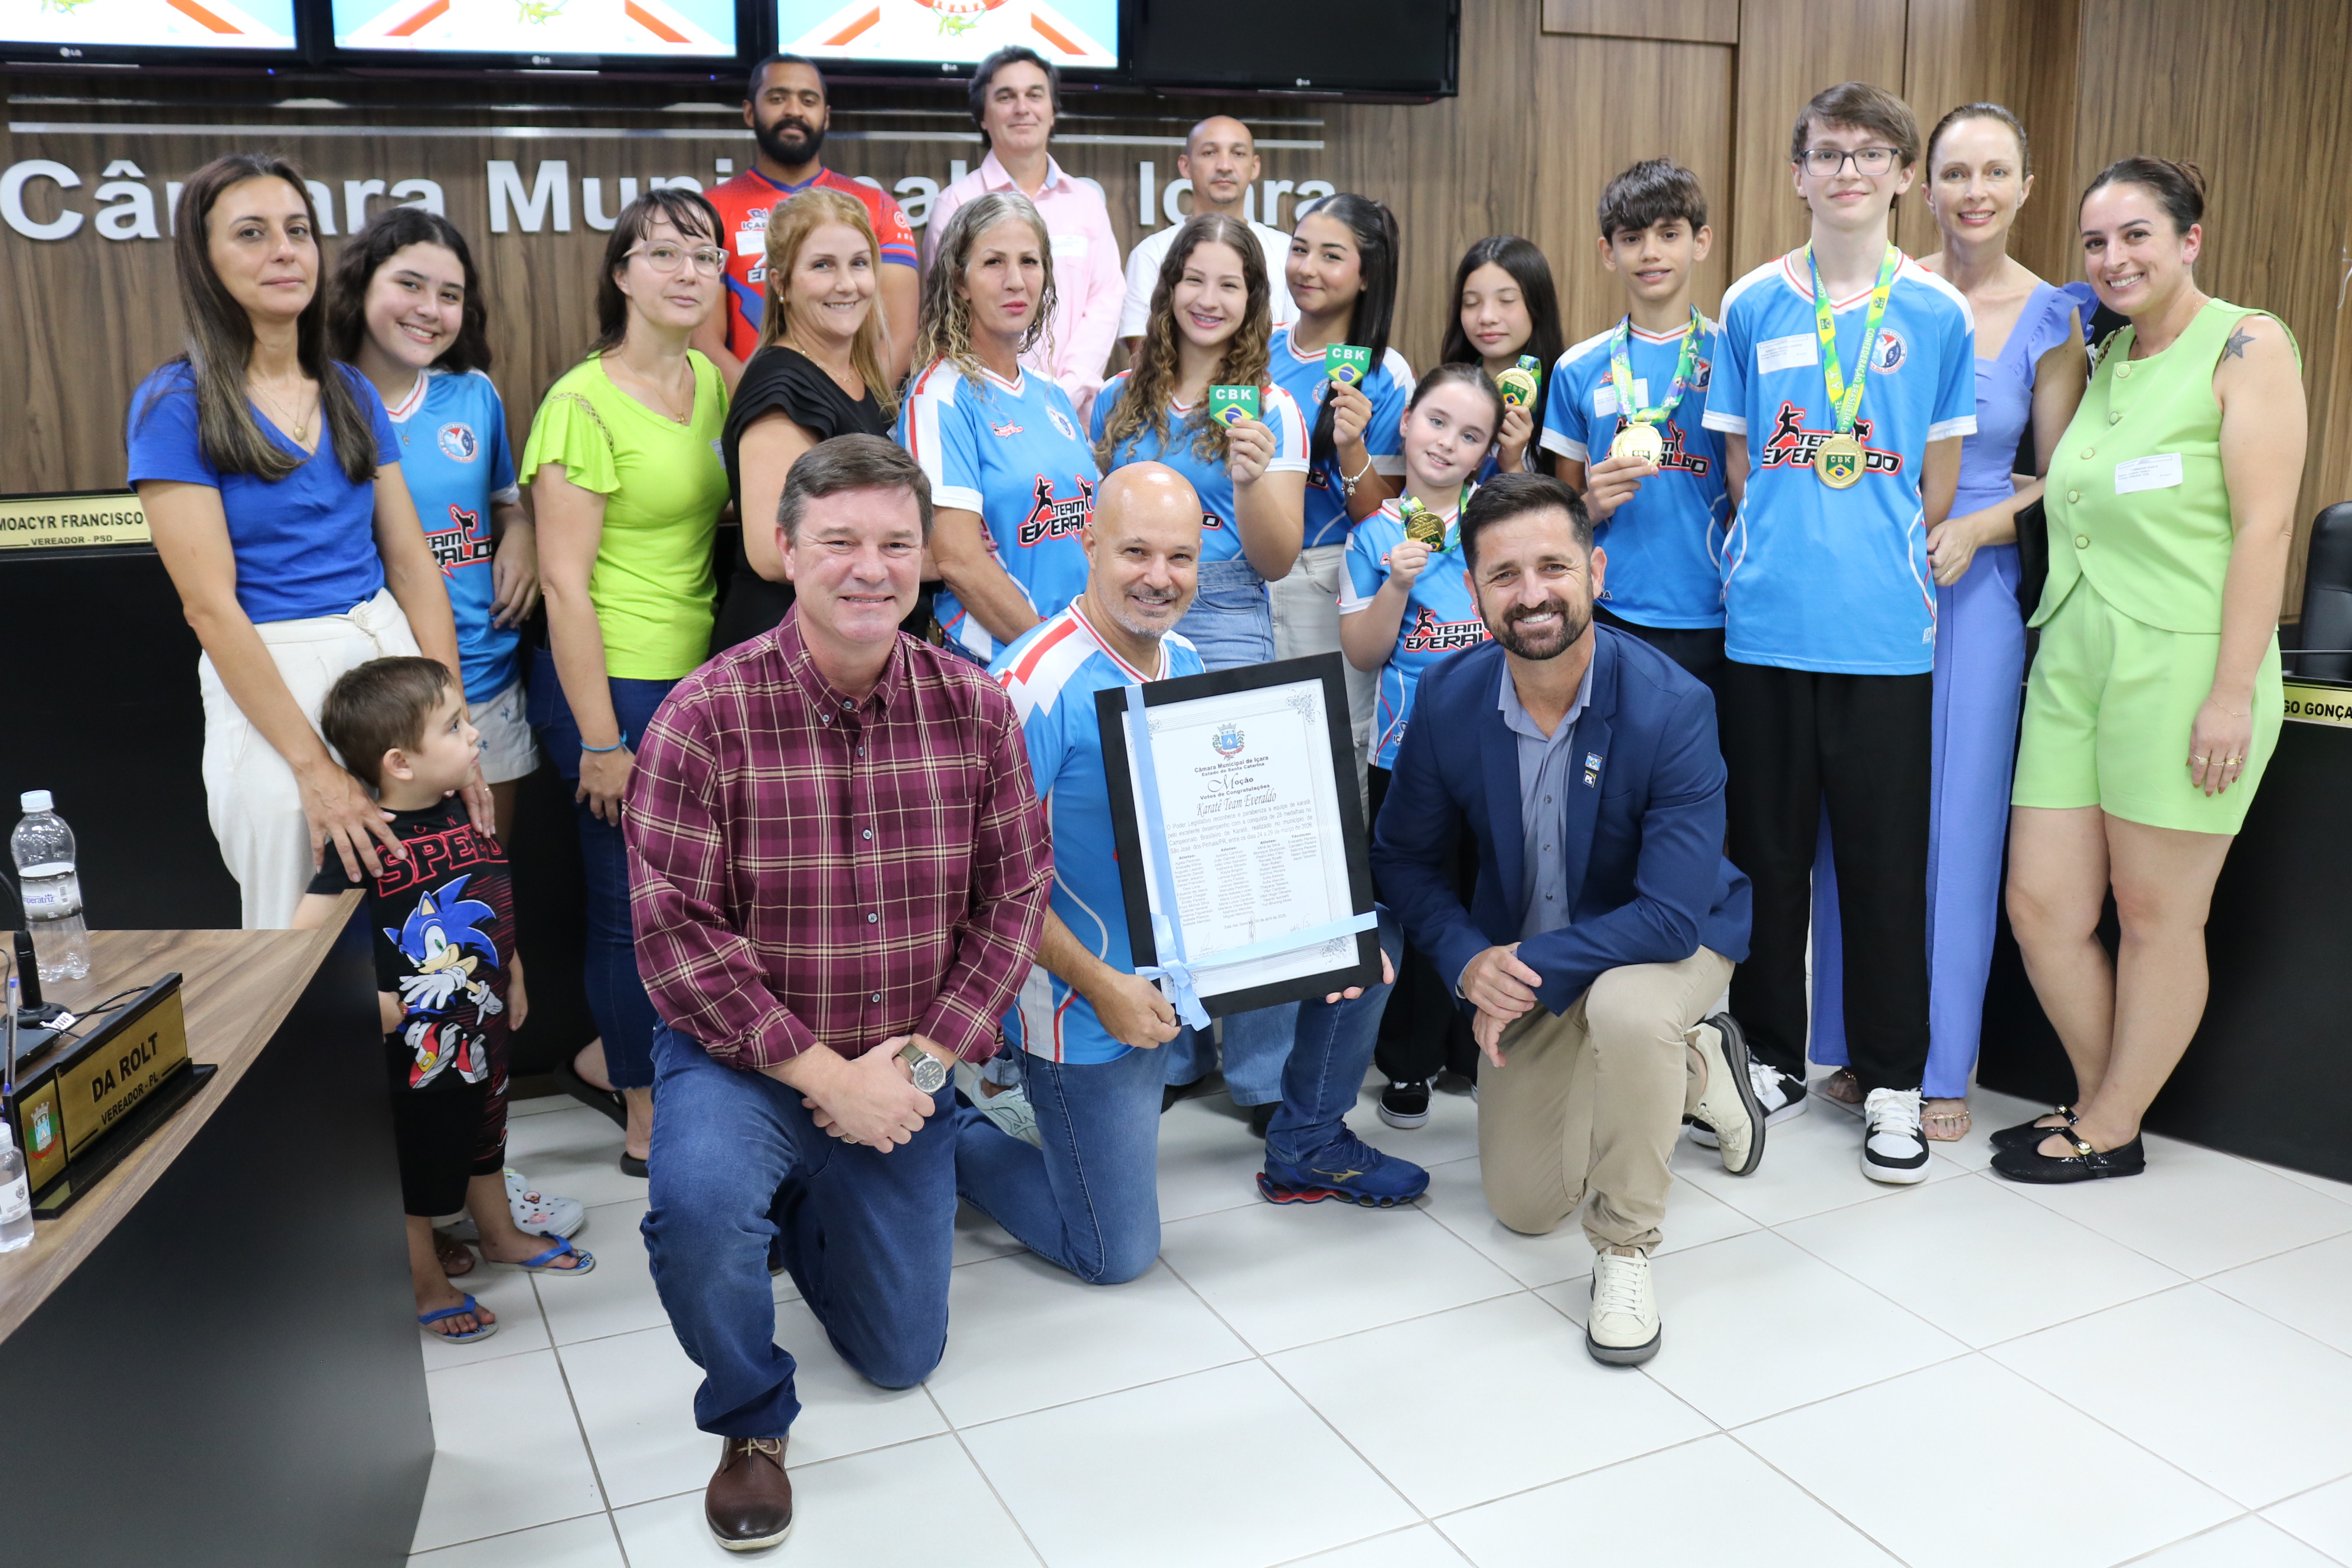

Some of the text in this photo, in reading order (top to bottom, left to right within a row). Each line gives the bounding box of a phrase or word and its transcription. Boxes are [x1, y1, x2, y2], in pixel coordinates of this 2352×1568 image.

[1332, 348, 1365, 361] CBK
[1855, 328, 1875, 383] CONFEDERAÇÃO
[1216, 388, 1252, 400] CBK
[1842, 383, 1859, 426] BRASILEIRA
[1830, 455, 1851, 464] CBK
[1053, 501, 1084, 517] TEAM
[61, 511, 143, 528] FRANCISCO
[31, 536, 84, 545] VEREADOR
[1435, 623, 1482, 636] TEAM
[1194, 766, 1216, 774] Câmara
[1217, 759, 1246, 770] Municipal
[1208, 772, 1254, 793] Moção
[1585, 774, 1593, 783] PL
[1226, 785, 1270, 795] Congratulações
[1197, 788, 1276, 816] Karatê Team Everaldo
[1188, 816, 1211, 827] Legislativo
[1213, 814, 1236, 822] reconhece
[1243, 808, 1267, 818] parabeniza
[1273, 803, 1288, 812] equipe
[1169, 837, 1198, 846] Campeonato
[1200, 832, 1221, 841] Brasileiro
[1252, 822, 1272, 831] realizado
[1179, 828, 1200, 837] excelente
[1201, 822, 1230, 832] desempenho
[1247, 815, 1268, 824] conquista
[92, 1032, 158, 1103] DA ROLT
[101, 1083, 143, 1126] VEREADOR
[149, 1072, 158, 1088] PL
